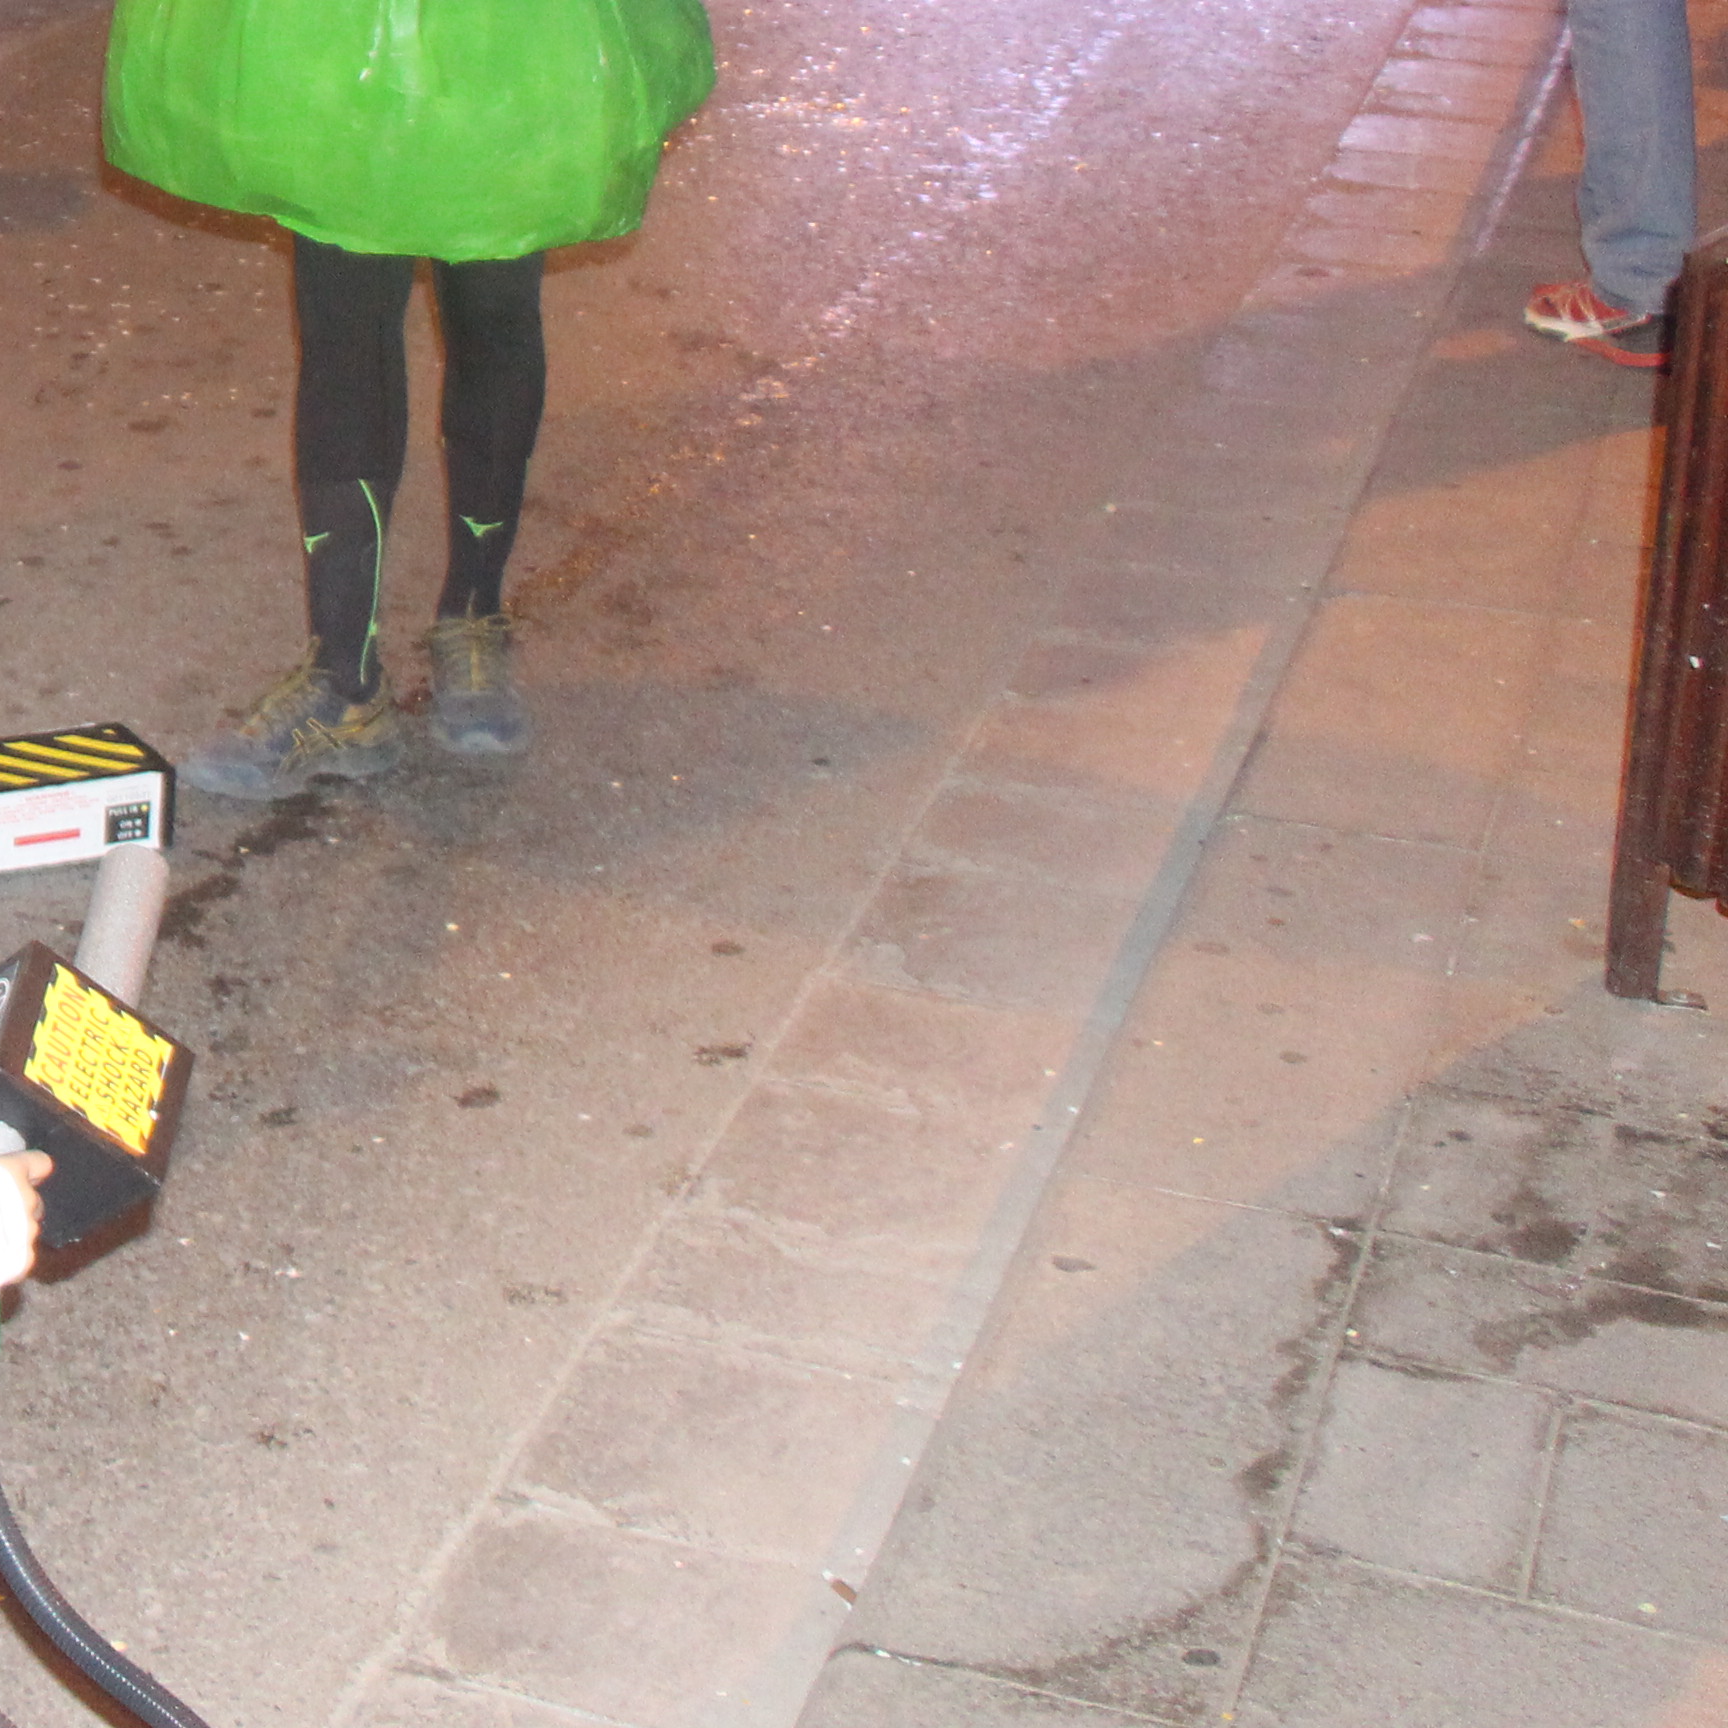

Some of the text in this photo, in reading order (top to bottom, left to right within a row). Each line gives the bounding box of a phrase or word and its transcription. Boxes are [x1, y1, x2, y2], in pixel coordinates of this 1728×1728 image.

[41, 985, 87, 1084] CAUTION
[69, 1007, 109, 1100] ELECTRIC
[96, 1035, 129, 1105] SHOCK
[117, 1048, 154, 1127] HAZARD
